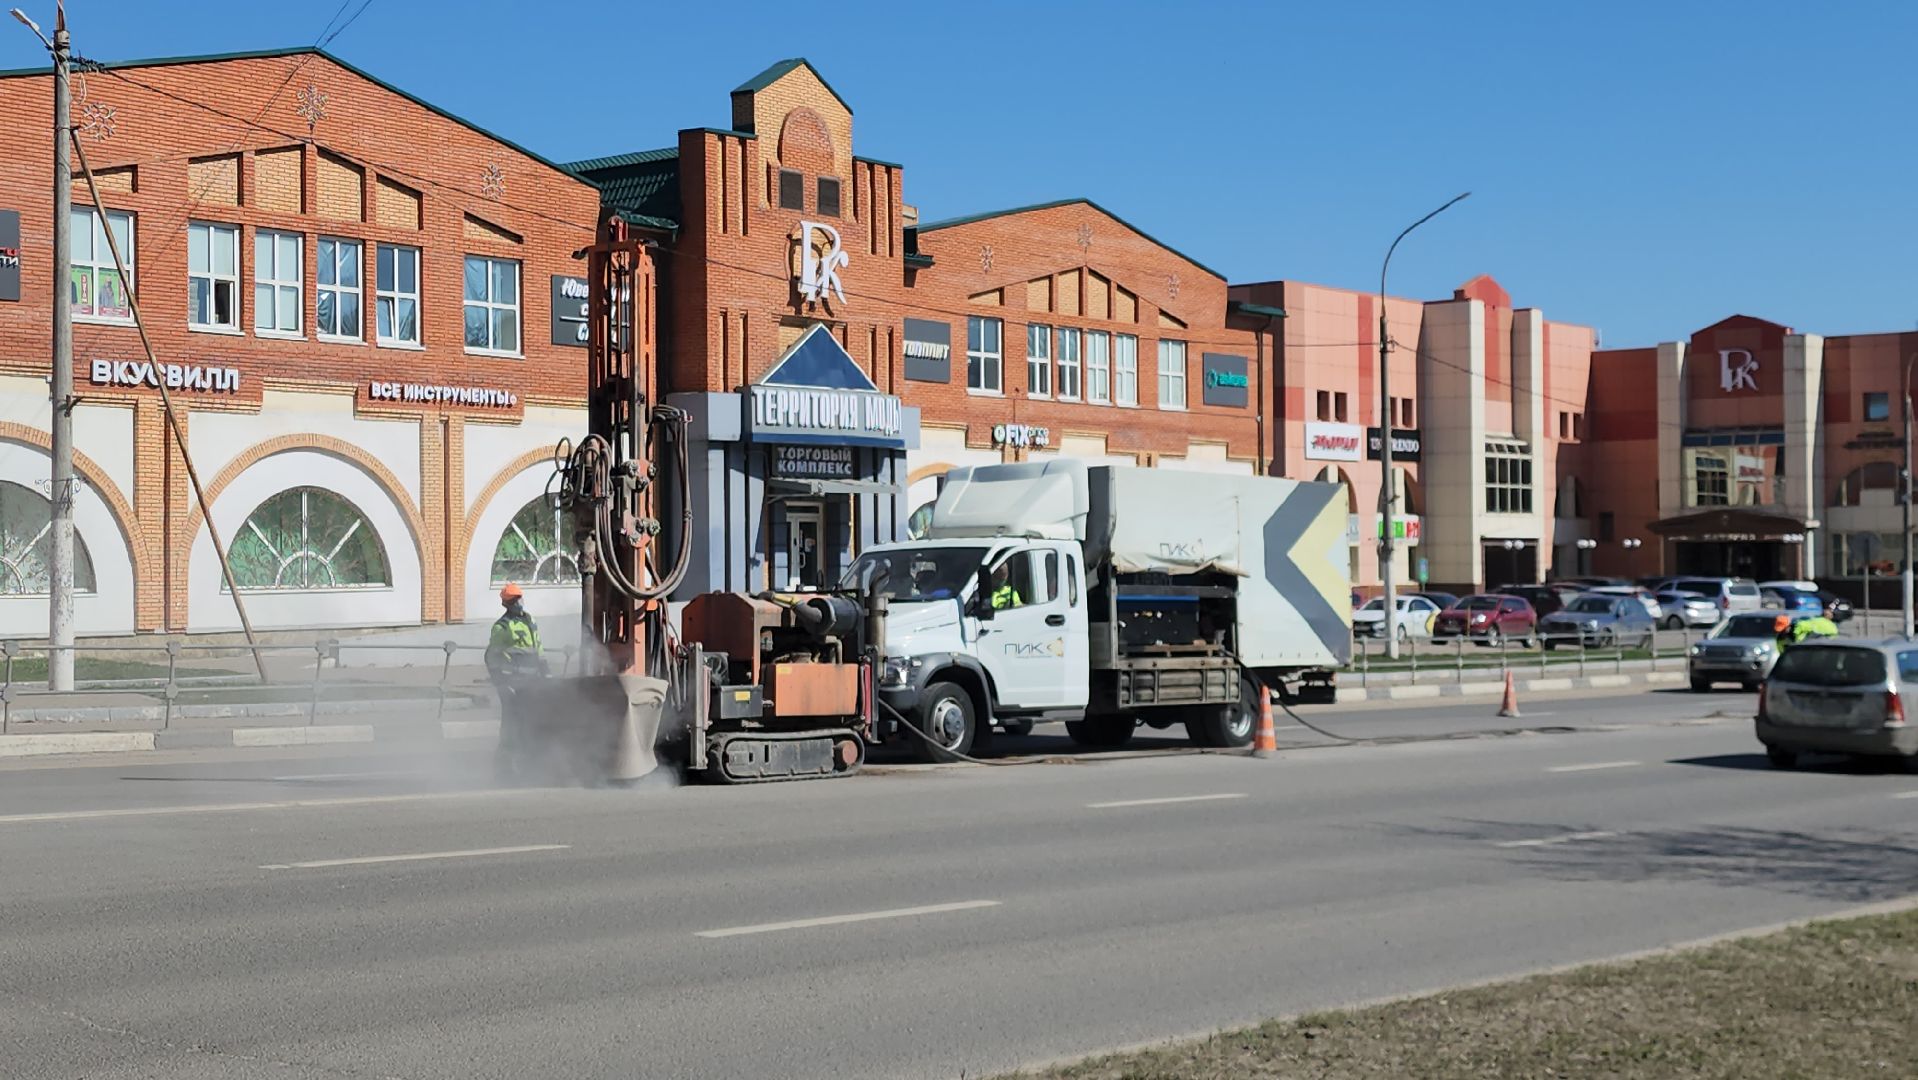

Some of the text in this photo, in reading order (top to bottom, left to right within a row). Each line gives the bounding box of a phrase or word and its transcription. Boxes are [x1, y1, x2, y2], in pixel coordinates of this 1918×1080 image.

[92, 359, 239, 391] ВКУСВИЛЛ
[371, 381, 509, 405] ВСЕ ИНСТРУМЕНТЫ
[753, 388, 902, 436] ТЕРРИТОРИЯ МОДЫ
[777, 447, 852, 462] ТОРГОВЫЙ
[777, 460, 852, 475] КОМПЛЕКС
[1004, 642, 1045, 656] ПИК
